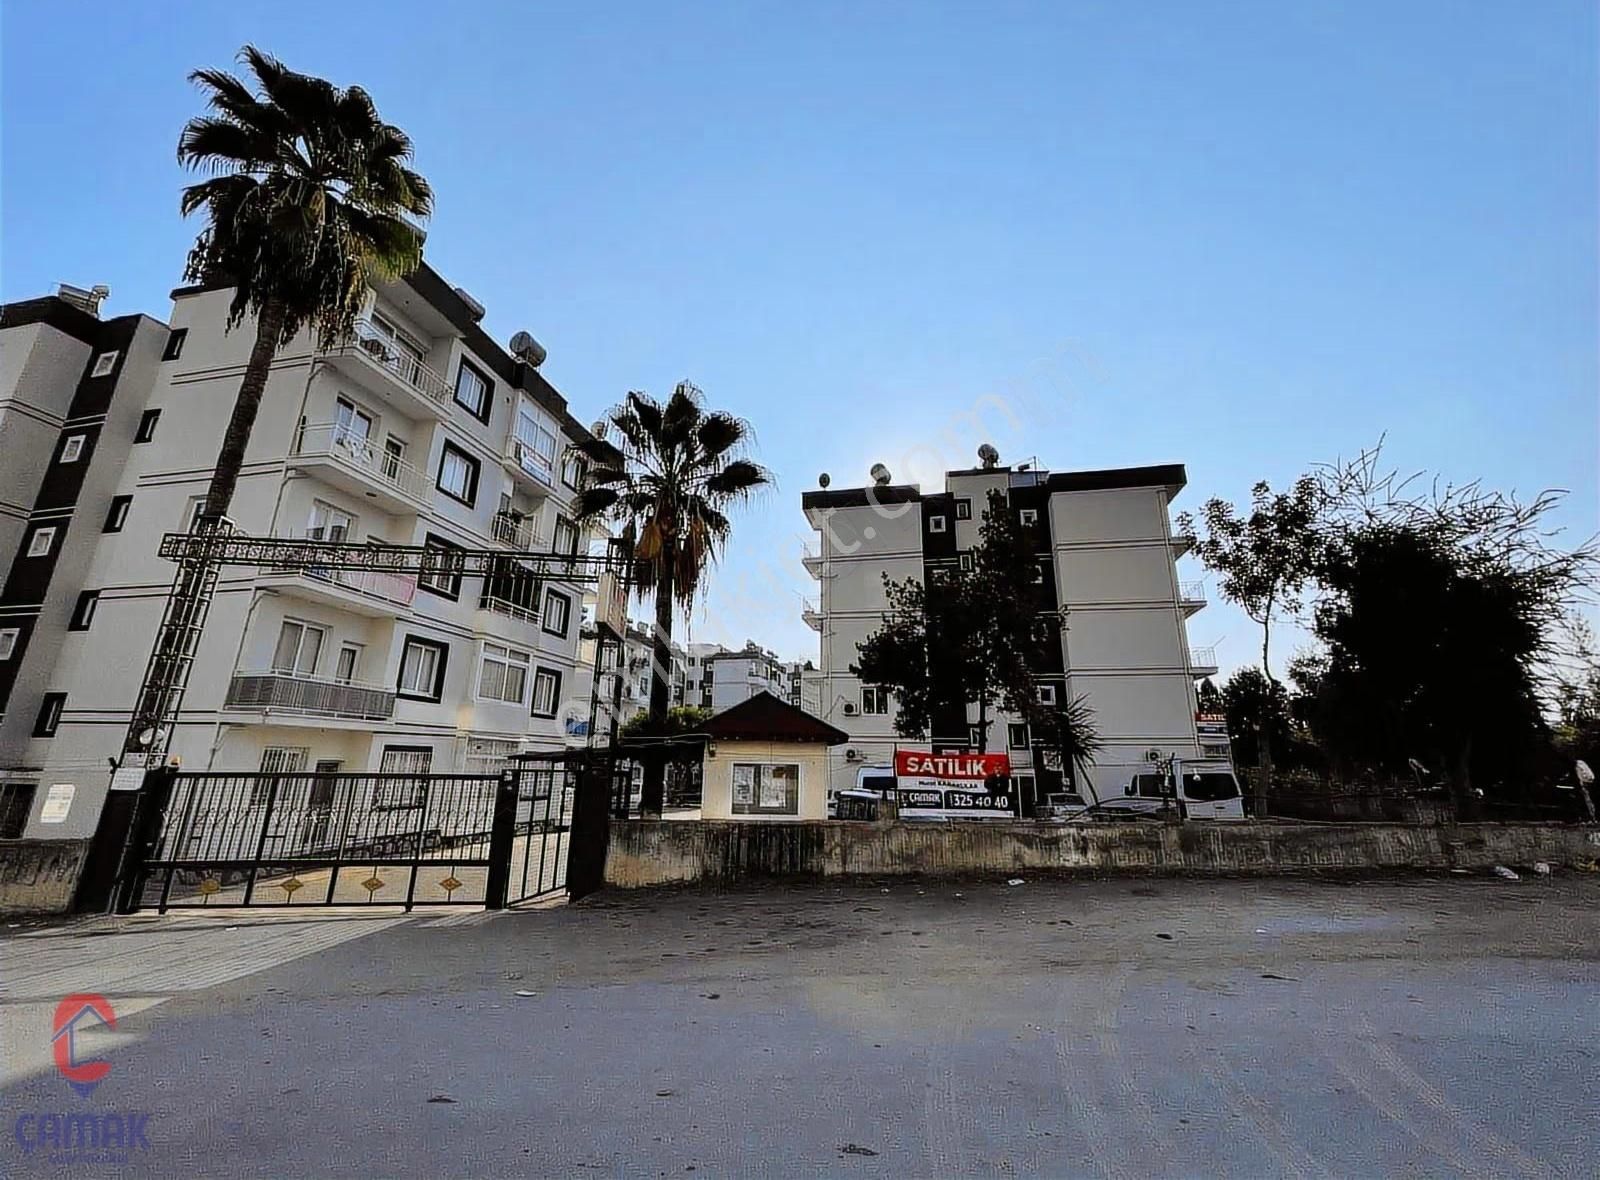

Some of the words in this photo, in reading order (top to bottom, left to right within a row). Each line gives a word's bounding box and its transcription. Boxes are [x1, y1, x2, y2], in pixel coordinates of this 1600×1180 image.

[906, 756, 987, 776] SATILIK
[953, 793, 973, 807] 325
[976, 796, 991, 807] 40
[995, 795, 1008, 808] 40
